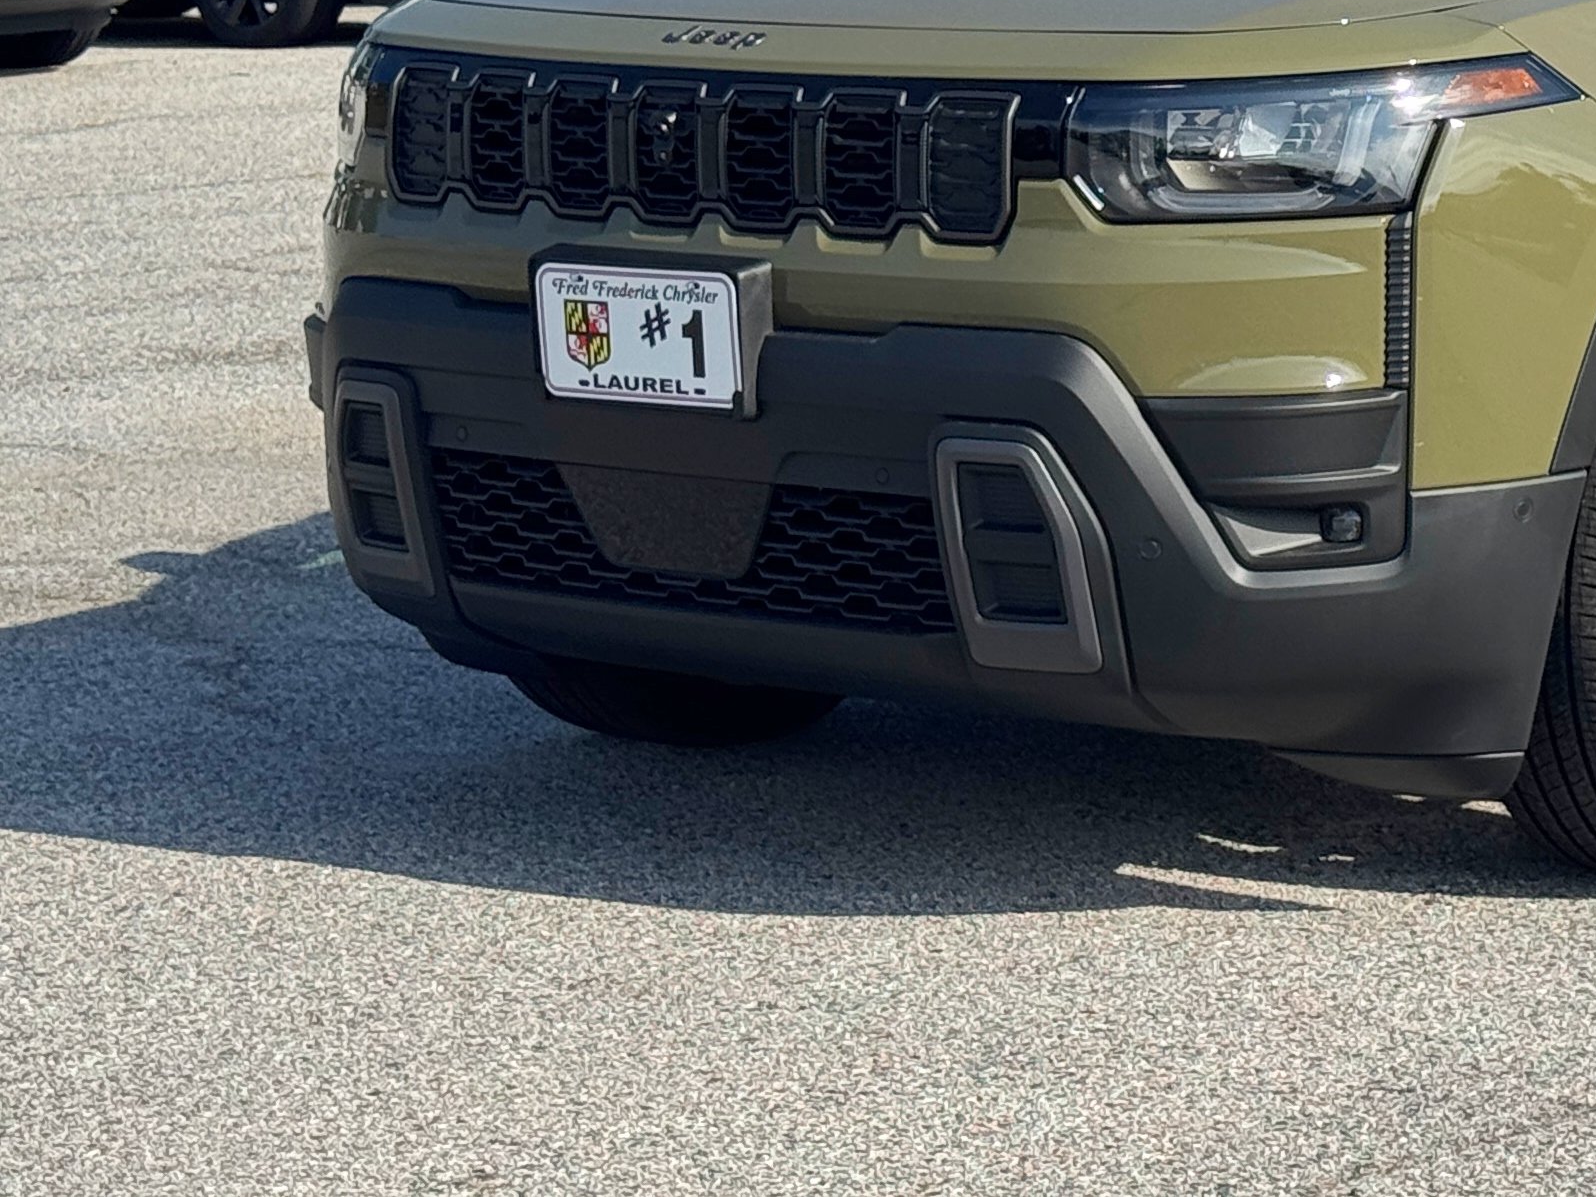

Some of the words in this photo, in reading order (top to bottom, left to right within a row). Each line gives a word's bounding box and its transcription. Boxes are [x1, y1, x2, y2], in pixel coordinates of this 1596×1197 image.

[661, 25, 767, 51] Jeep
[552, 277, 588, 295] Fred
[592, 280, 658, 301] Frederick
[662, 284, 718, 305] Chrysler
[593, 373, 689, 395] LAUREL
